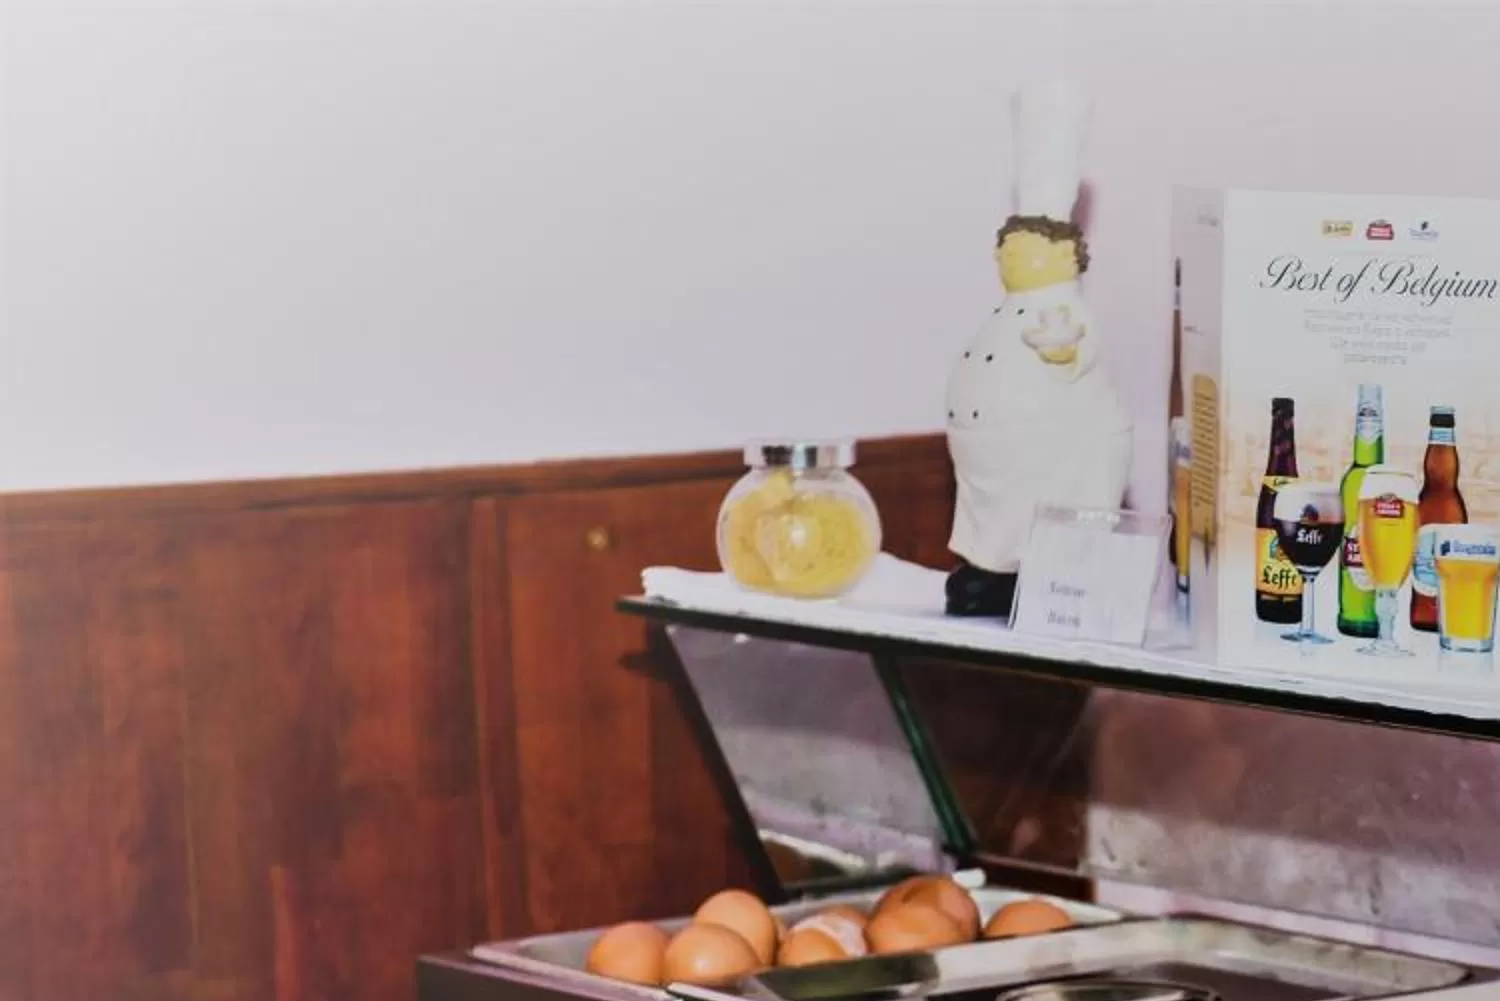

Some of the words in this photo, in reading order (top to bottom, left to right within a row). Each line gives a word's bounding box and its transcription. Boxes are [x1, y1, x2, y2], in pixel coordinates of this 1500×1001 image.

[1259, 255, 1334, 292] Best
[1333, 258, 1378, 303] of
[1370, 259, 1499, 308] Belgium
